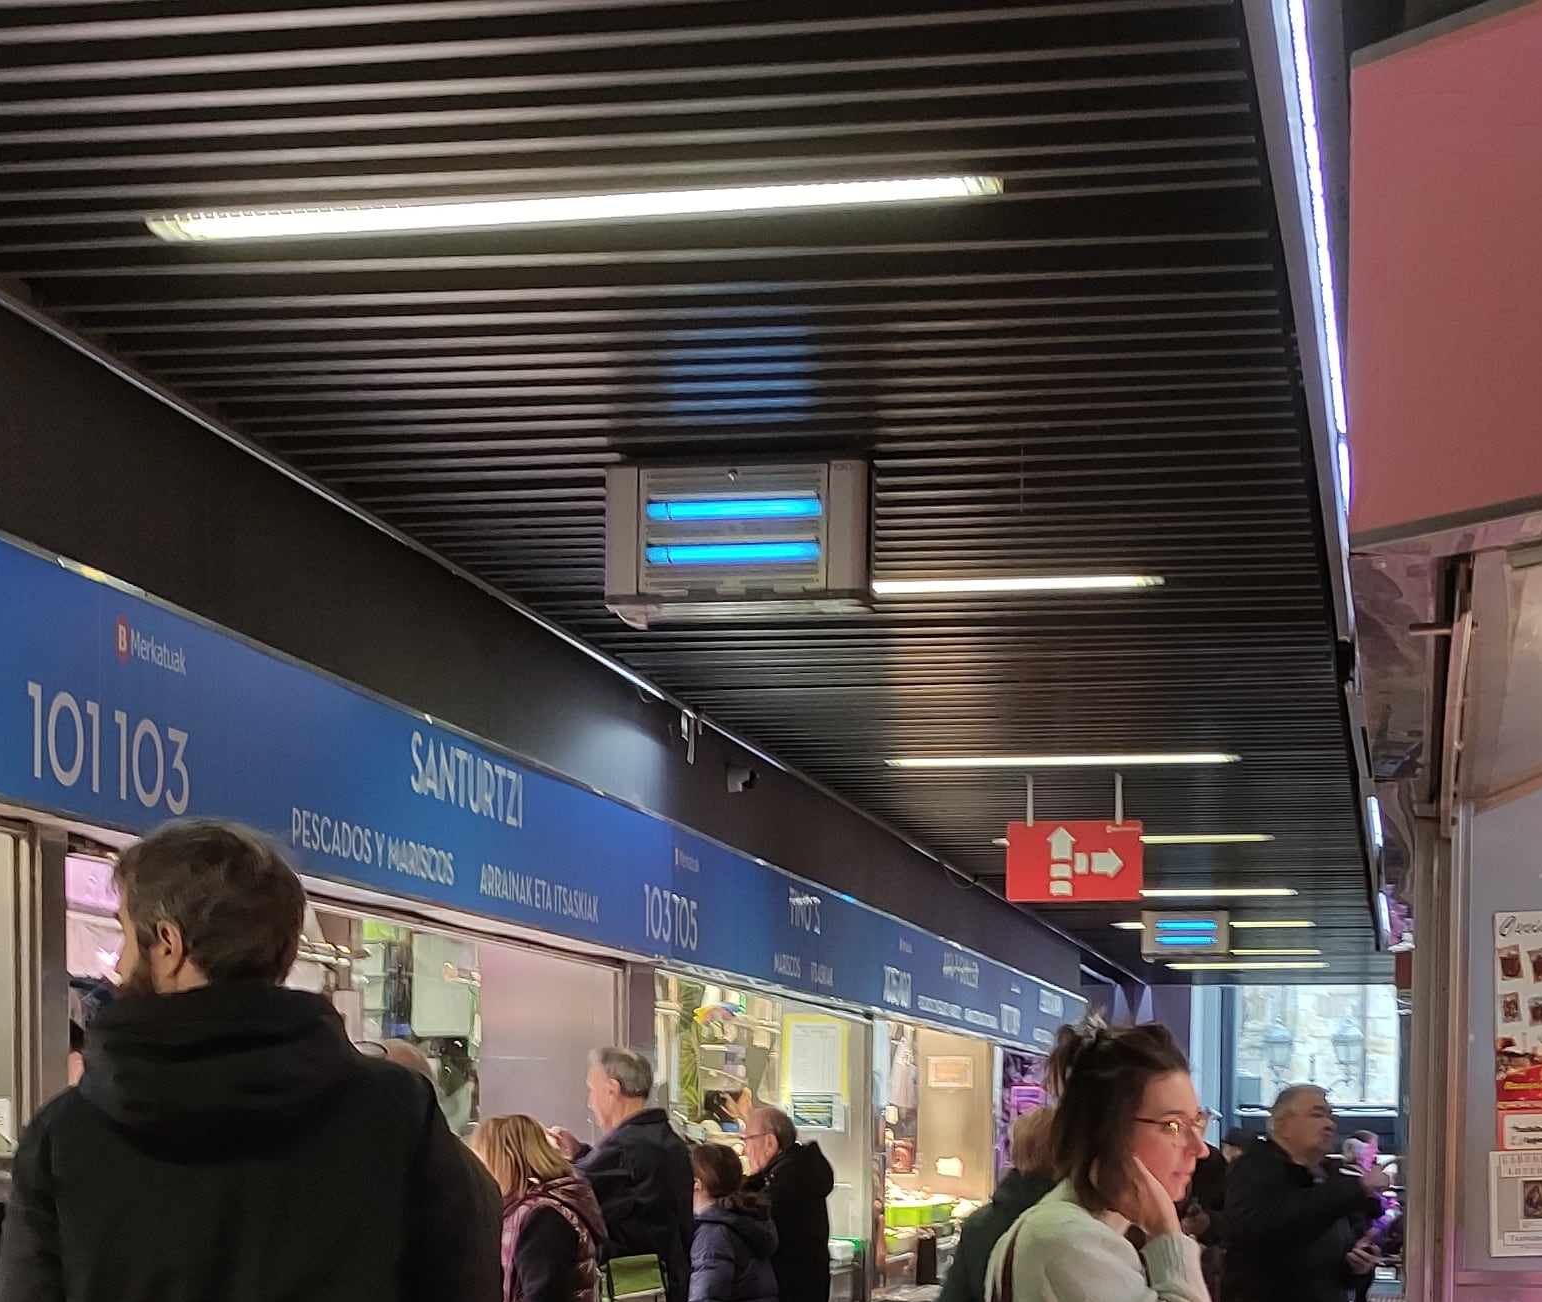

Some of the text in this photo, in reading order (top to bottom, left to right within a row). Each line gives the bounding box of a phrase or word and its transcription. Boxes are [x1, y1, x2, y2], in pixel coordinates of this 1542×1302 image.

[130, 629, 187, 676] Merkatuak
[27, 681, 190, 815] 101 103
[411, 731, 523, 829] SANTURTZI
[291, 807, 455, 886] PESCADOS Y MARISCOS
[480, 863, 599, 925] ARRAINAK ETA ITSASKIAK
[644, 883, 698, 951] 103 105
